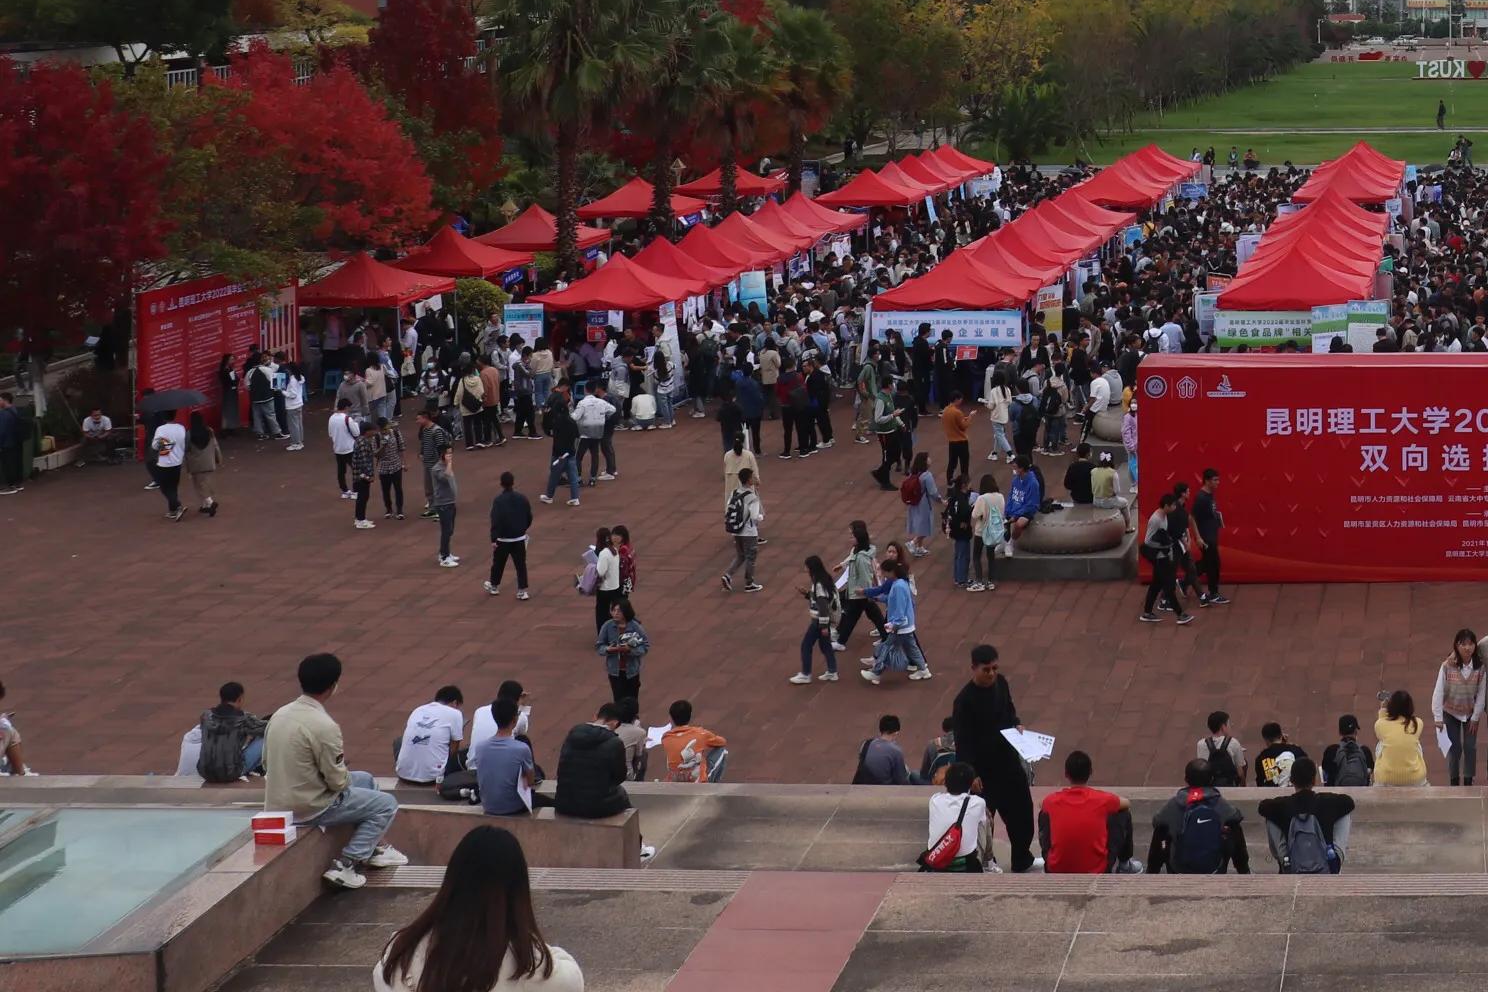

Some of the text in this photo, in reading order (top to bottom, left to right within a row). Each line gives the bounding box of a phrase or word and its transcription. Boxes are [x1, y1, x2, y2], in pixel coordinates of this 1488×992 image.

[1350, 495, 1444, 503] 昆明市人力资源和社会保障局
[1343, 520, 1458, 528] 昆明市呈贡区人力资源和社会保障局
